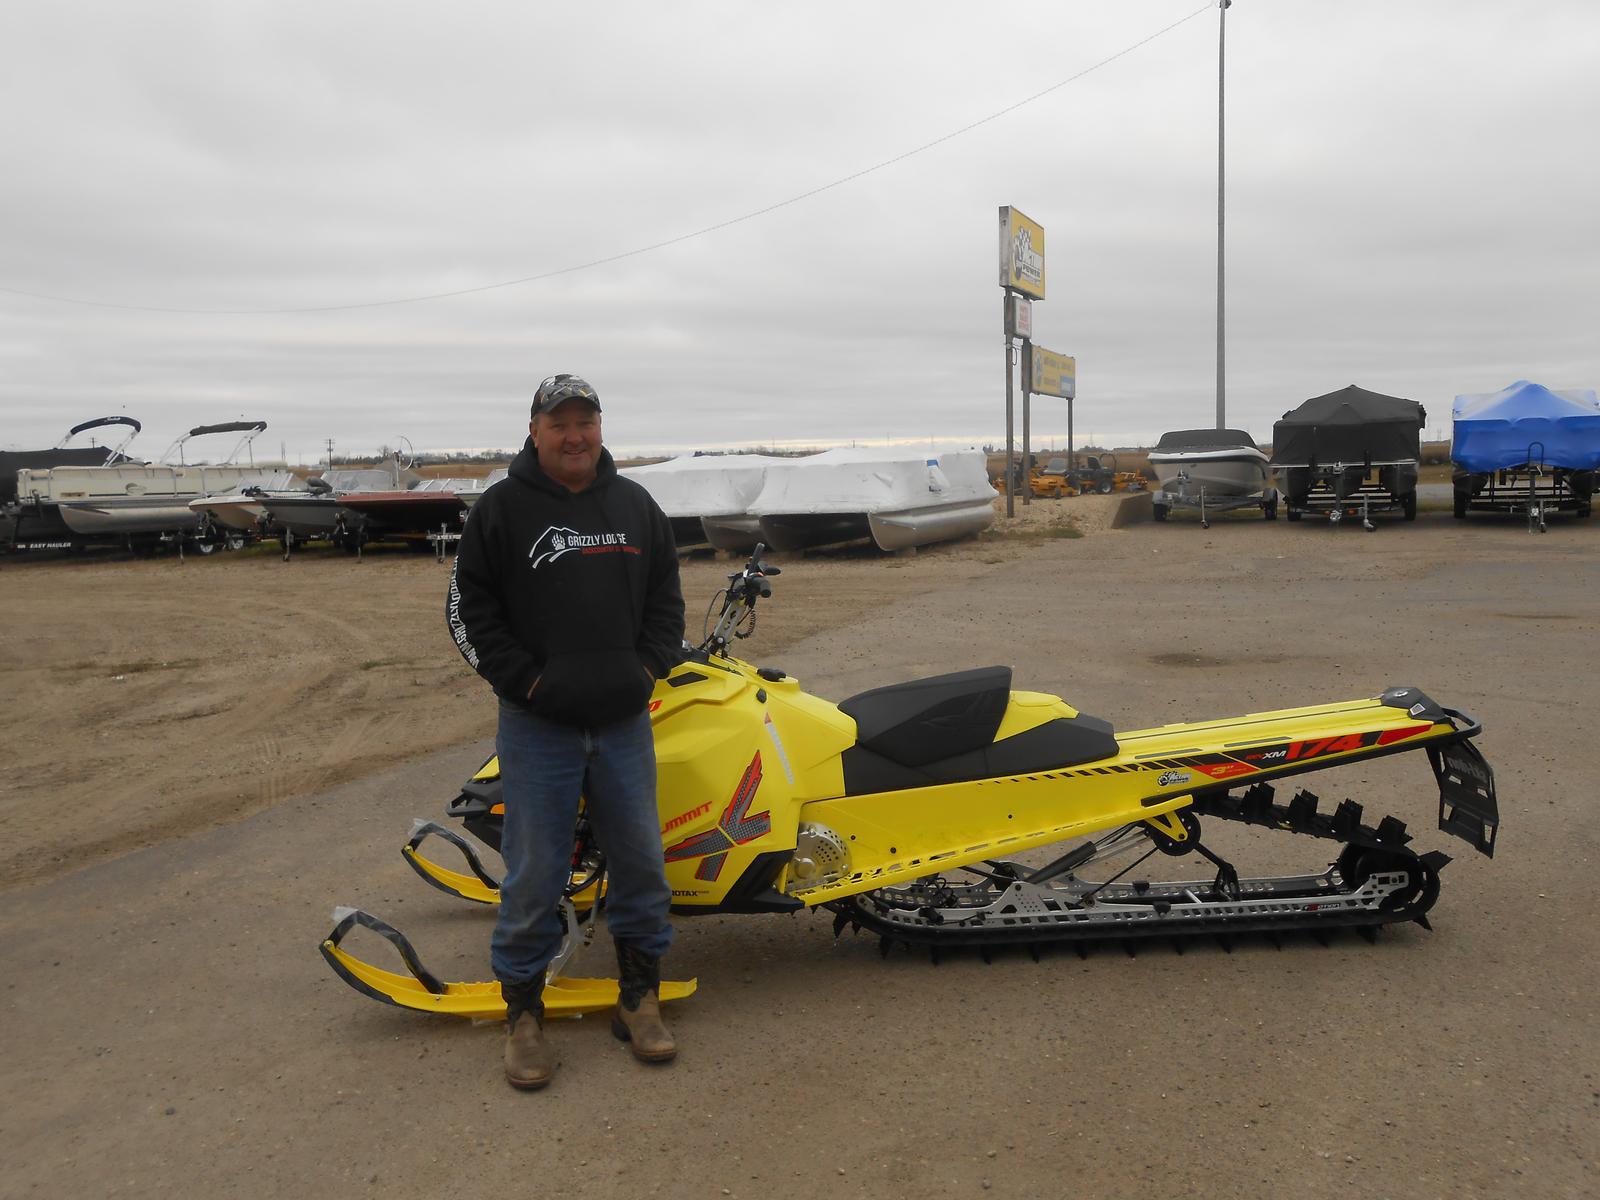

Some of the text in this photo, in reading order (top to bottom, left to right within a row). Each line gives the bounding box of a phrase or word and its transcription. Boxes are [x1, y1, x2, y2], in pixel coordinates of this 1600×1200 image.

[567, 534, 600, 547] GRIZZLY
[1284, 733, 1366, 761] 174
[660, 800, 713, 834] UMMIT
